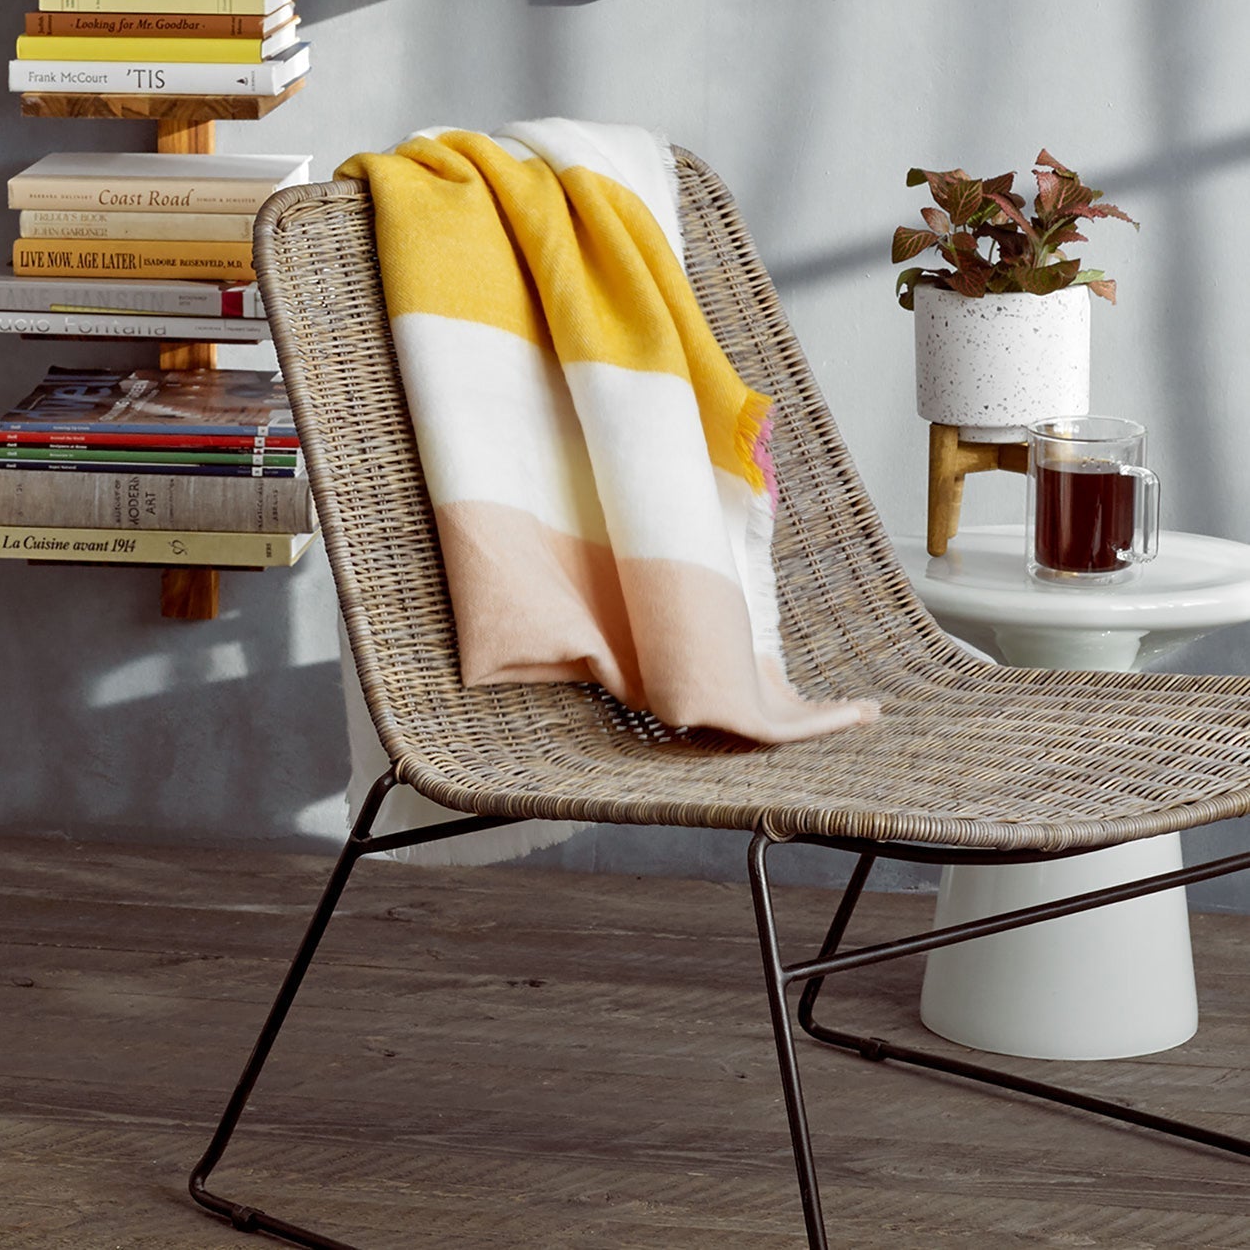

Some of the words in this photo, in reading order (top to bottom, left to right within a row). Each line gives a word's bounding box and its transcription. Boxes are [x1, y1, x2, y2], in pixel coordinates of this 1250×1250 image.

[75, 18, 116, 33] Looking
[117, 18, 134, 33] for
[136, 18, 154, 30] Mr.
[155, 17, 200, 31] Goodbar
[28, 71, 57, 83] Frank
[60, 72, 108, 84] McCourt
[126, 68, 166, 90] 'TIS
[98, 189, 142, 207] Coast
[147, 188, 195, 207] Road
[80, 213, 108, 223] BOOK
[33, 226, 59, 237] JOHN
[61, 227, 108, 238] GARDNER
[20, 251, 45, 269] LIVE
[77, 252, 98, 269] AGE
[102, 253, 137, 270] LATER
[143, 258, 177, 267] ISADORE
[179, 258, 226, 269] ROSENFELD,
[227, 259, 243, 269] M.D.
[128, 476, 141, 526] MODERN
[145, 491, 157, 516] ART
[2, 535, 21, 550] La
[23, 535, 71, 552] Cuisine
[73, 539, 109, 553] avant
[111, 539, 137, 553] 1914
